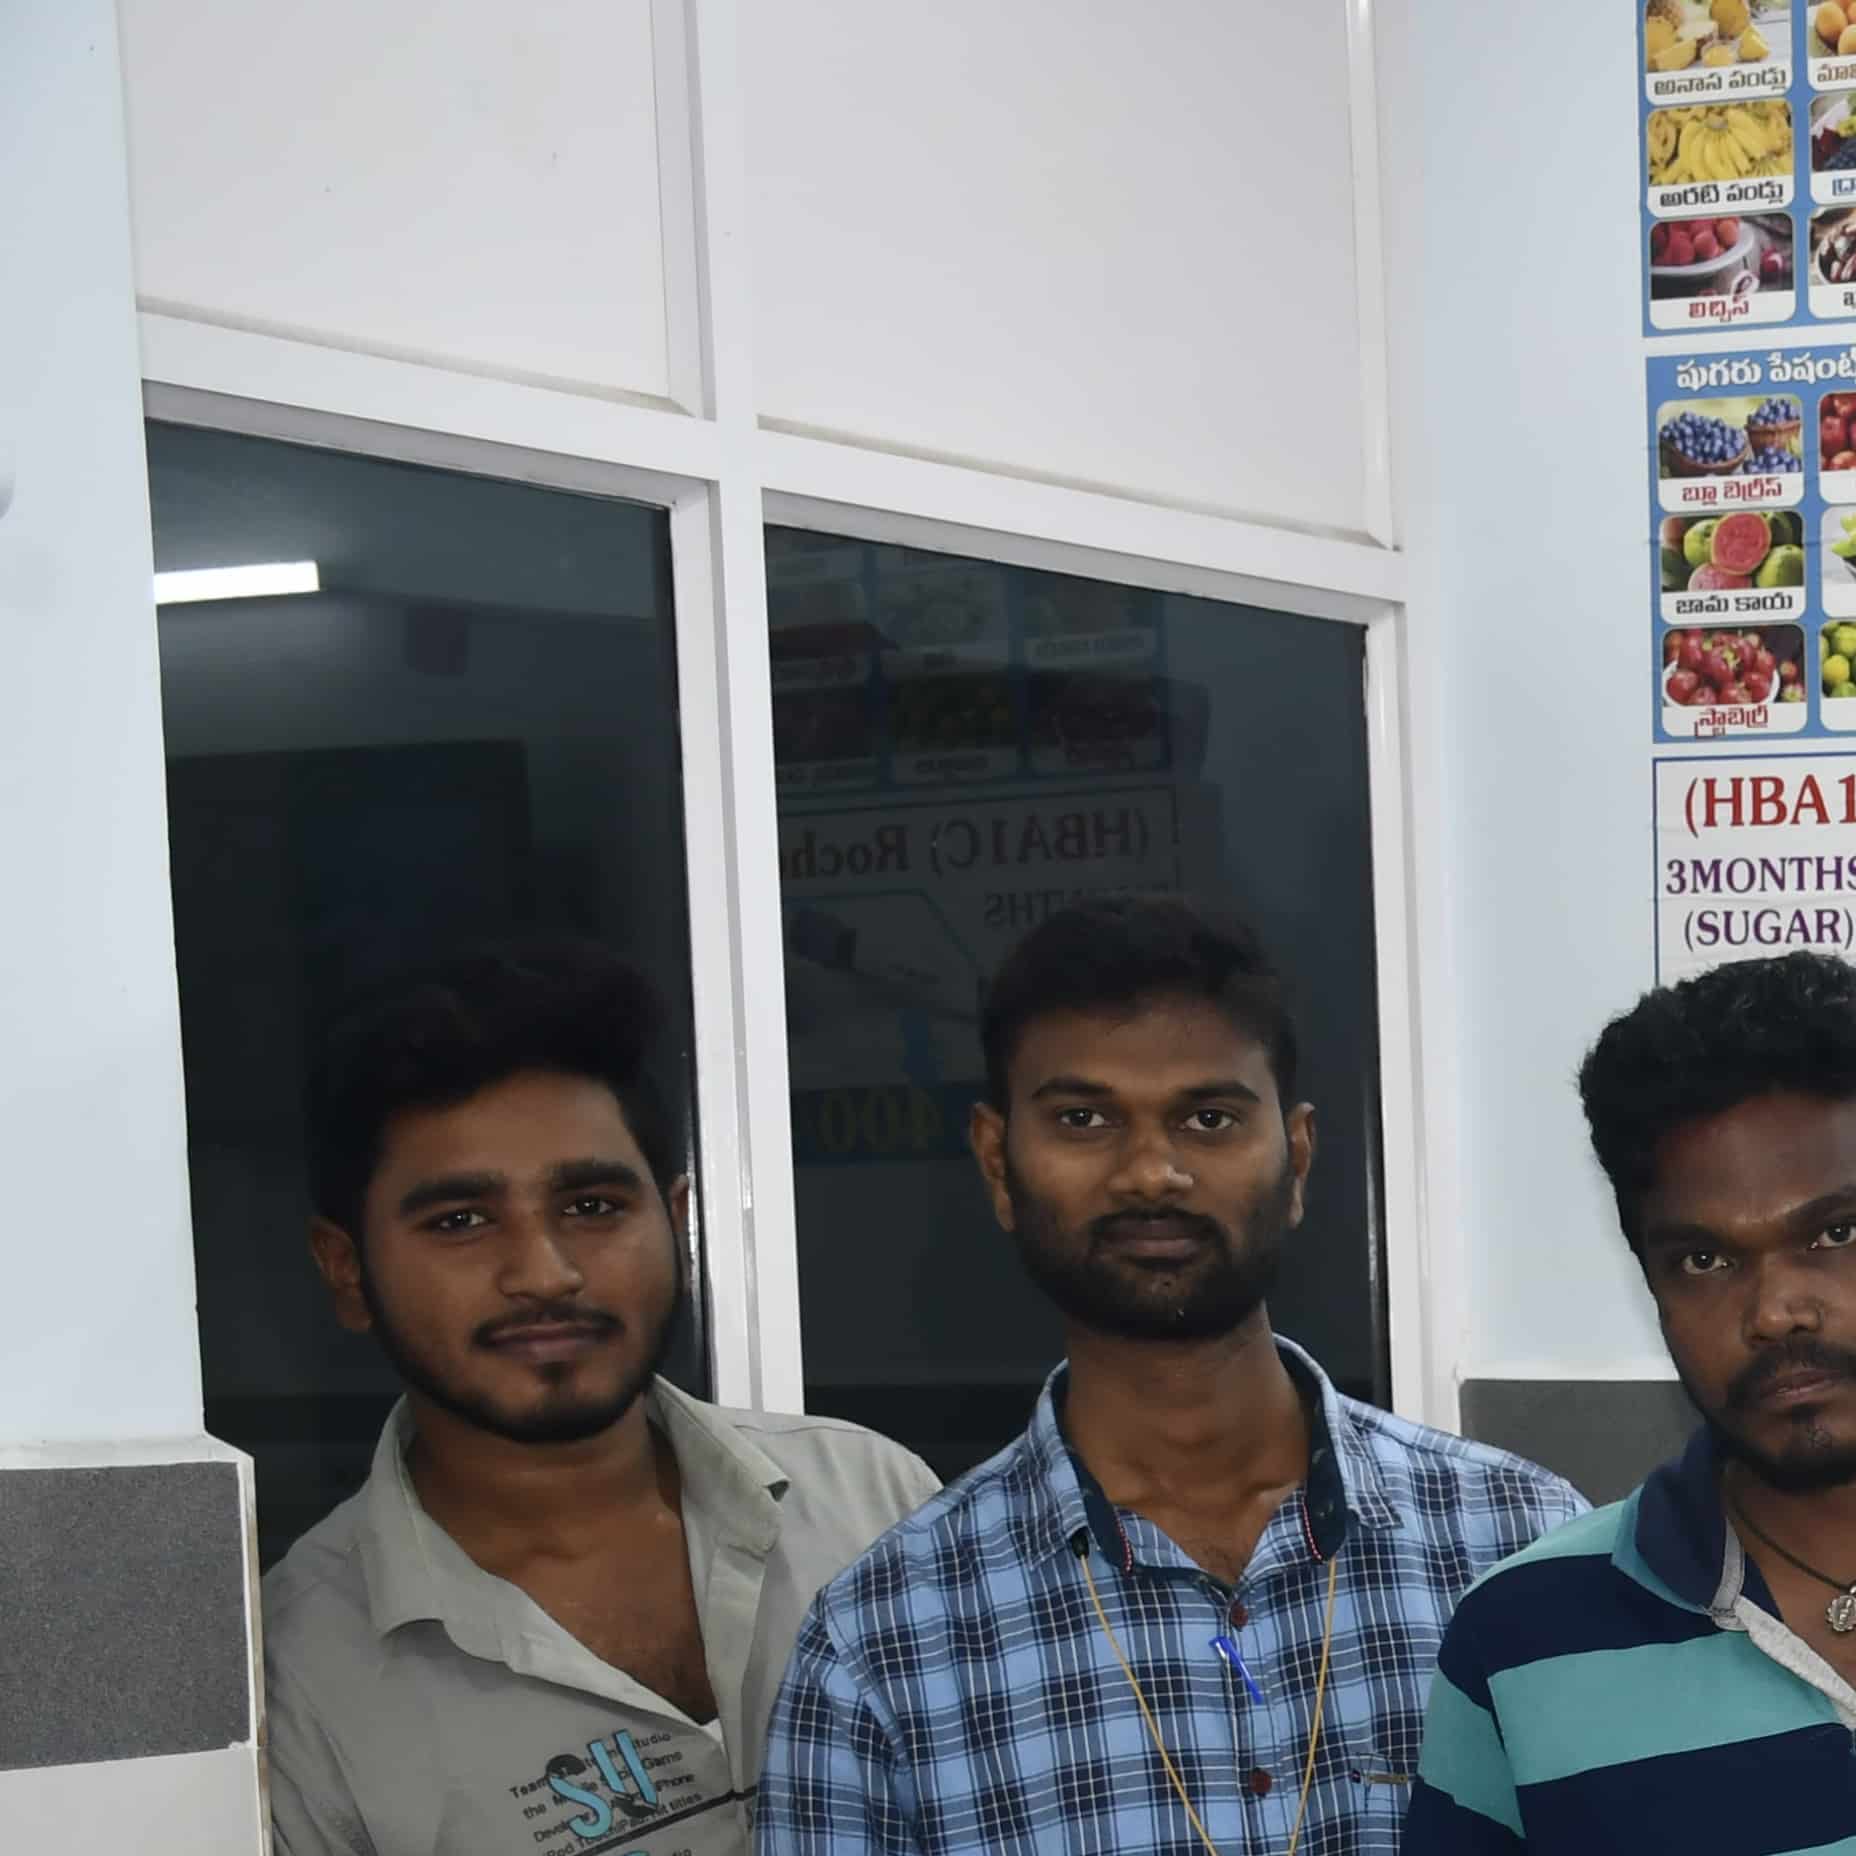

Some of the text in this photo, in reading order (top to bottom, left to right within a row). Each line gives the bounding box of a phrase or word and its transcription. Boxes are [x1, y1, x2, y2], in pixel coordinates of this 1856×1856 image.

[1654, 67, 1787, 95] అనాస పండ్లు
[1660, 180, 1783, 209] అరటి పండ్లు
[1677, 358, 1761, 390] షుగరు
[1676, 591, 1793, 615] జామ కాయ
[1684, 908, 1854, 950] (SUGAR)
